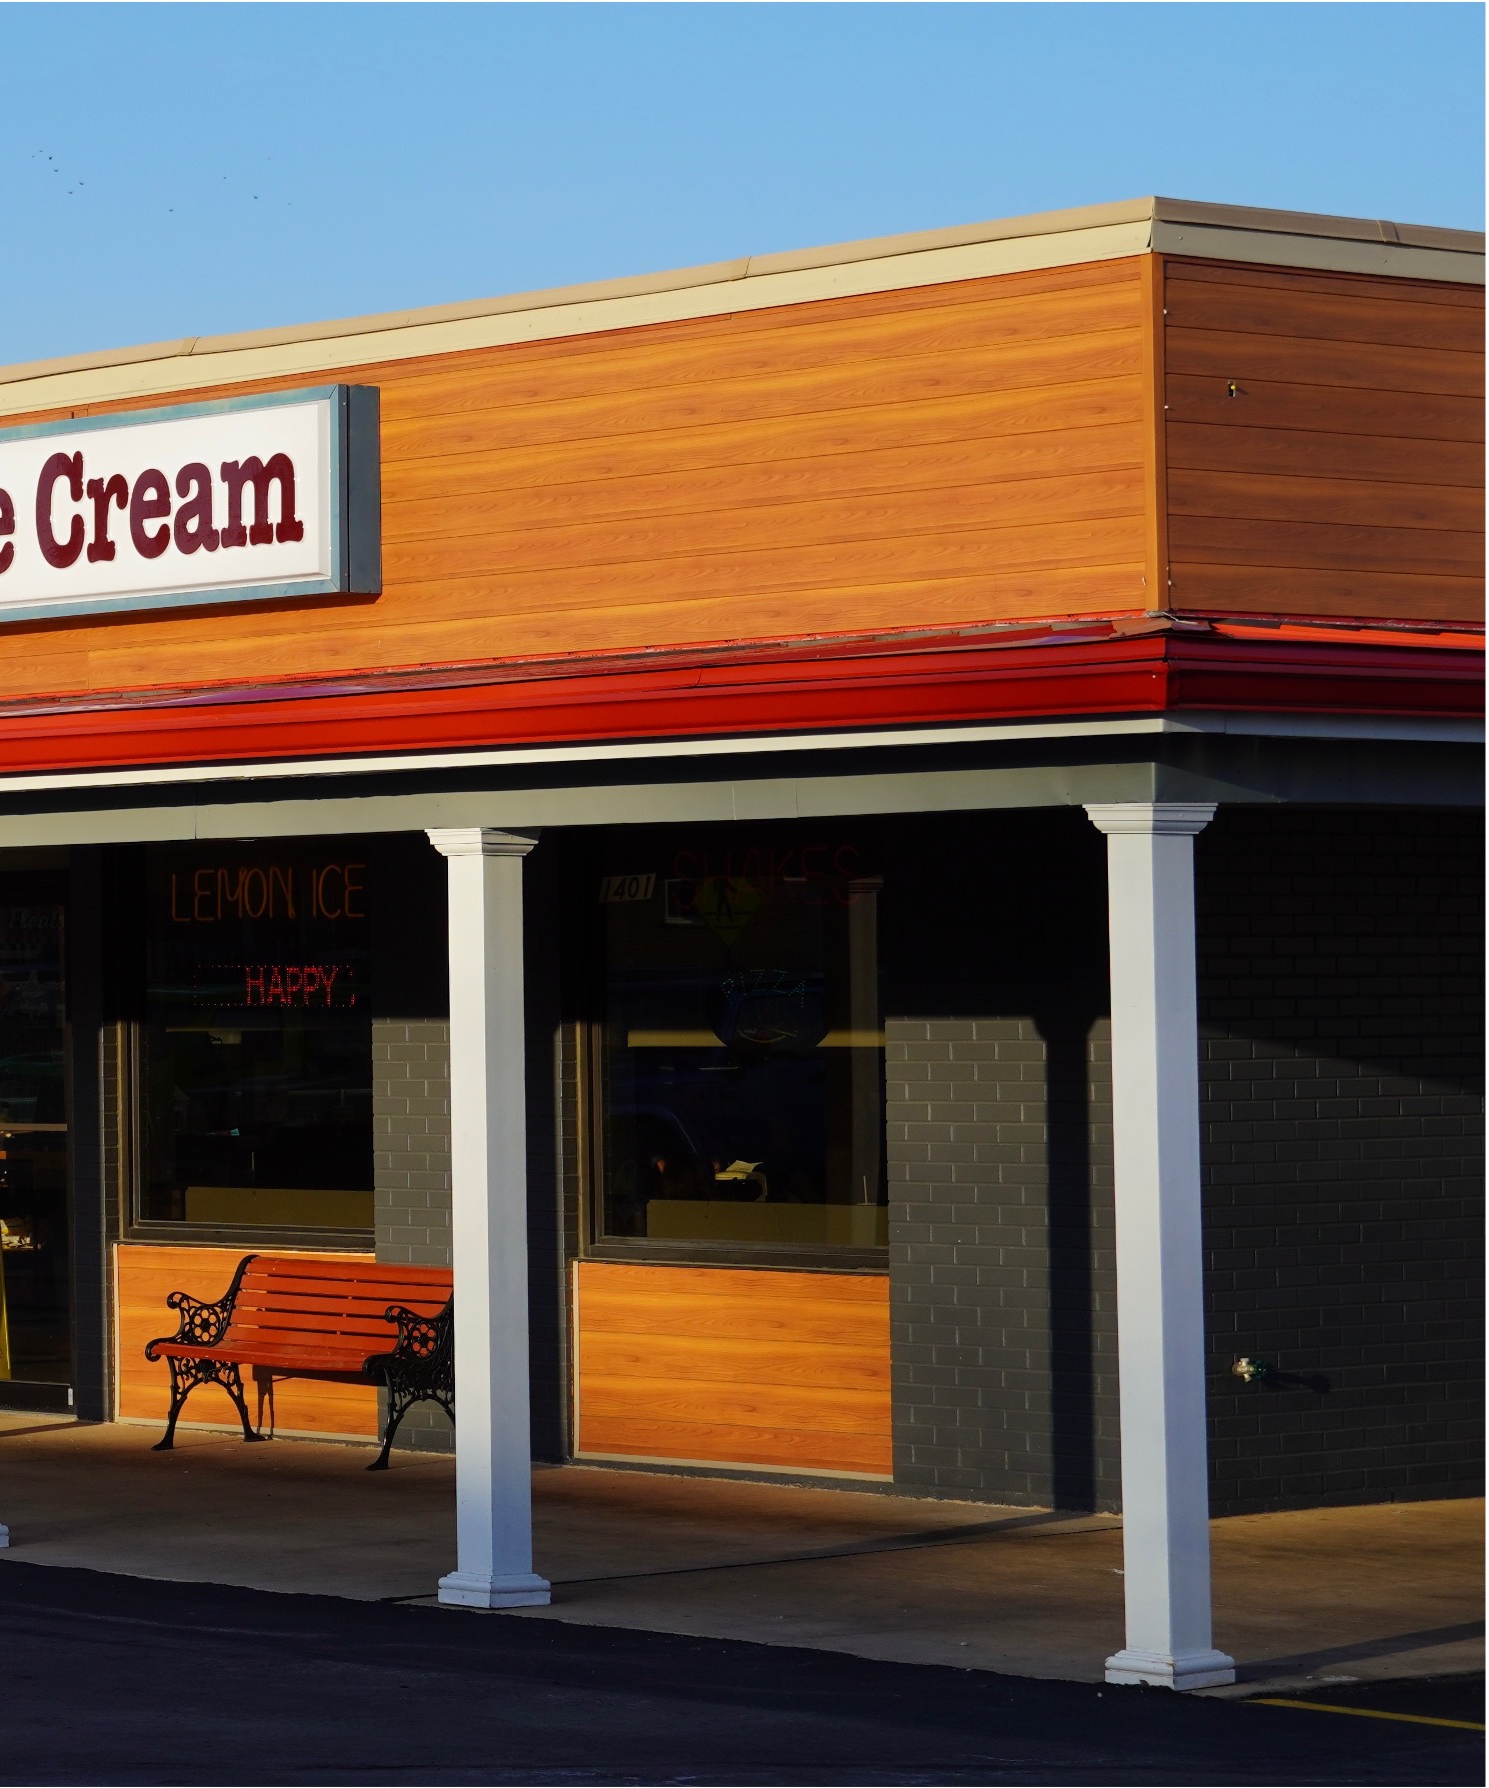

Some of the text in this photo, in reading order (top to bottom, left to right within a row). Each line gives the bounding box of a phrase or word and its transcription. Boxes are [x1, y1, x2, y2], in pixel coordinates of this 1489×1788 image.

[36, 450, 305, 570] Cream
[170, 863, 367, 923] LEMON ICE
[604, 875, 652, 899] 1401
[245, 965, 339, 1008] HAPPY
